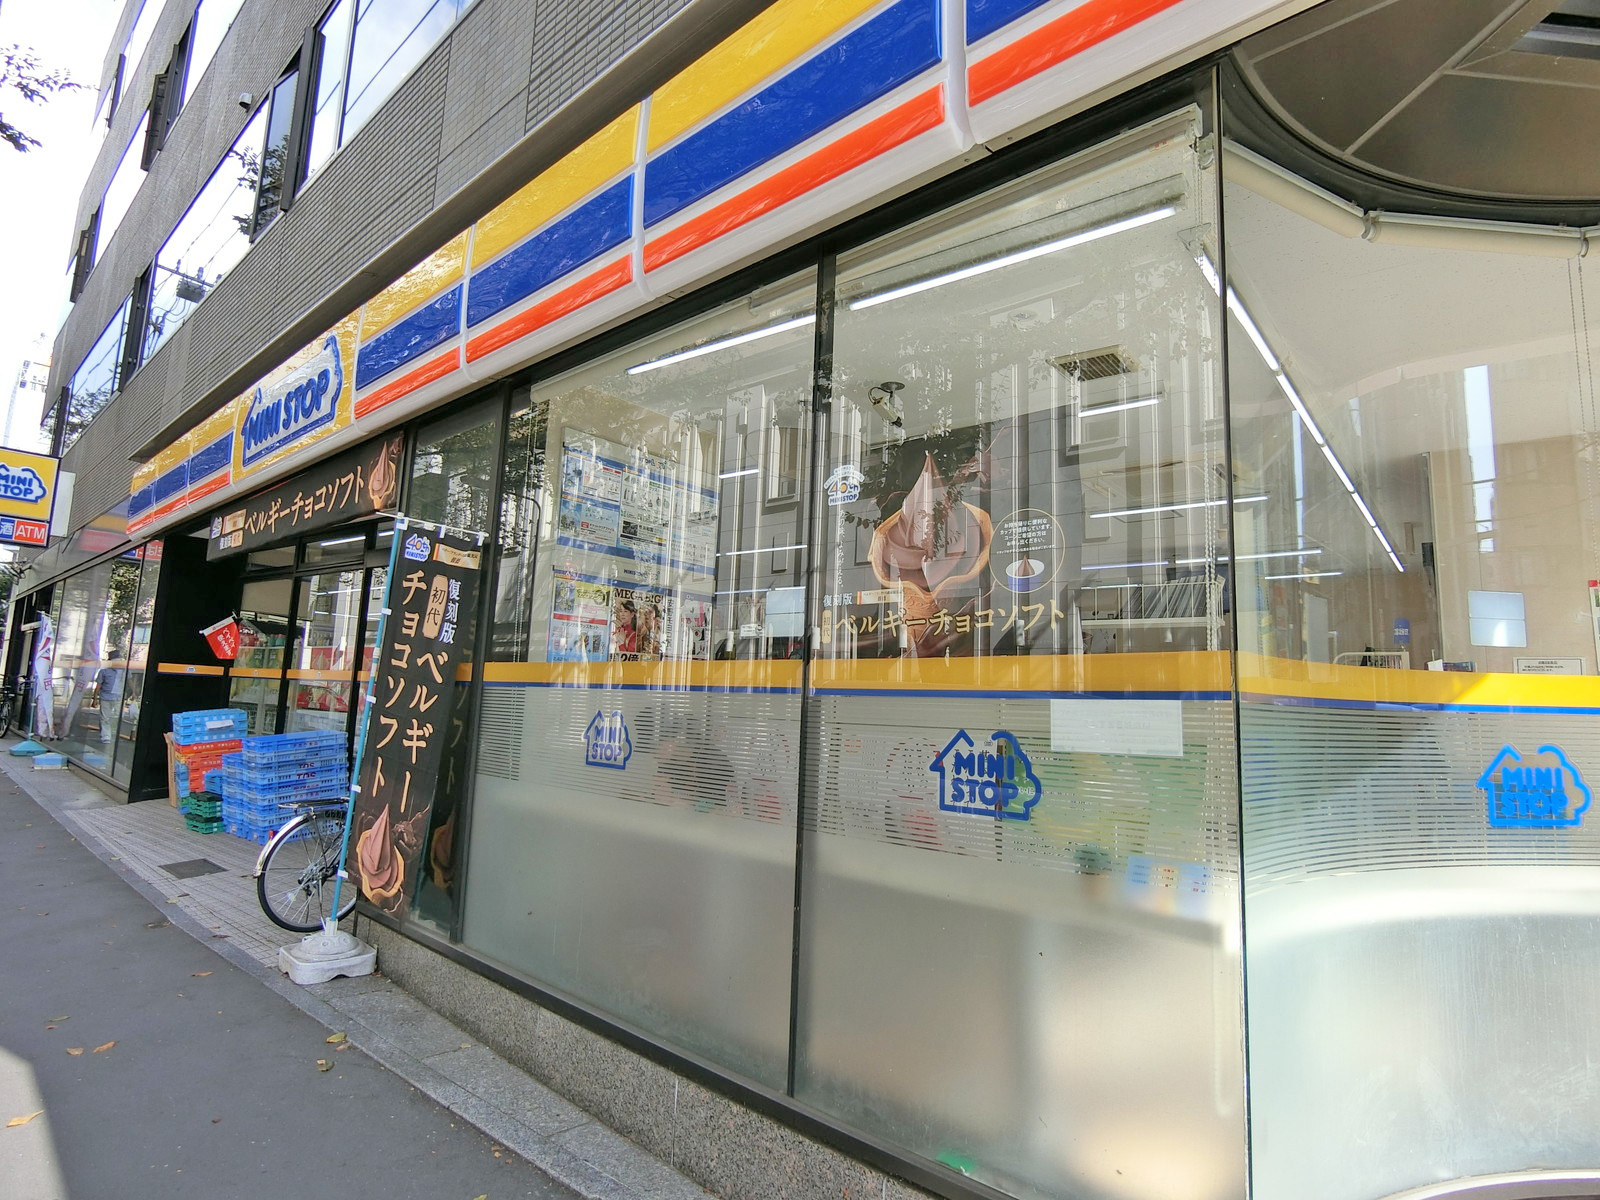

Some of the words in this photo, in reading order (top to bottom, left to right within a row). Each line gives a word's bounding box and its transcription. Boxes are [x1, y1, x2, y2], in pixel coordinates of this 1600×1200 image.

[244, 398, 283, 451] MINI
[282, 368, 331, 431] STOP
[0, 484, 34, 498] TOP
[244, 465, 365, 535] ベルギーチョコソフト
[16, 524, 46, 540] ATM
[426, 586, 447, 627] 初代
[439, 578, 462, 645] 復刻版
[823, 592, 853, 608] 復刻版
[835, 599, 1066, 638] ベルギーチョコソフト
[372, 569, 428, 797] チョコソフト
[400, 650, 449, 813] ベルギー
[594, 725, 622, 745] MINI
[592, 742, 622, 762] STOP
[954, 751, 1015, 780] MINI
[951, 777, 1019, 807] STOP
[1501, 766, 1564, 791] MINI
[1500, 790, 1569, 818] STOP
